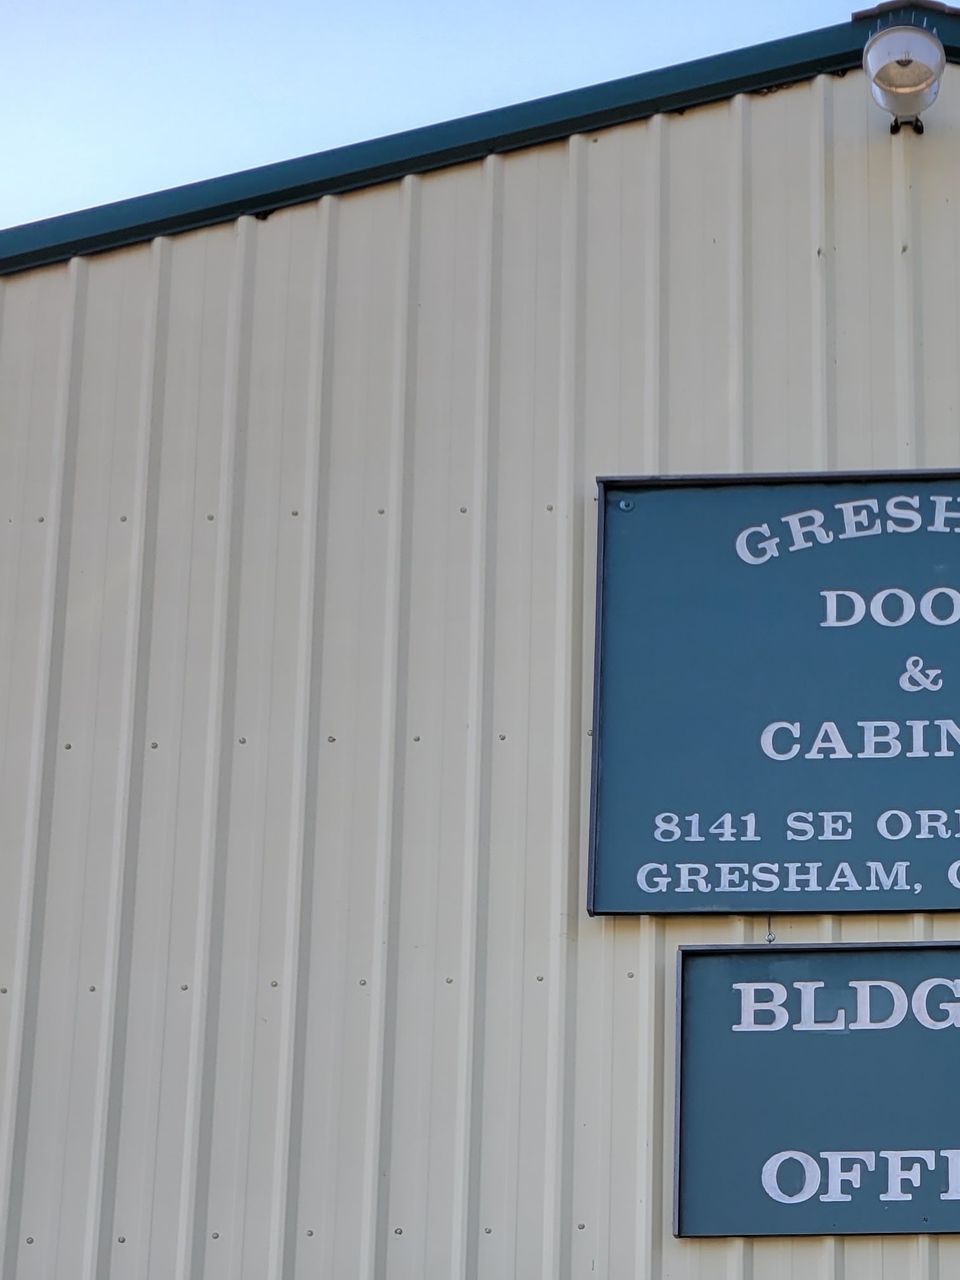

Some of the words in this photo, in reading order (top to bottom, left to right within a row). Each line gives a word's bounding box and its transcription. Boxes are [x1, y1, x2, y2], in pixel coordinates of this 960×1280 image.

[899, 656, 943, 692] &
[654, 812, 761, 842] 8141
[786, 811, 852, 841] SE
[636, 861, 923, 894] GRESHAM,
